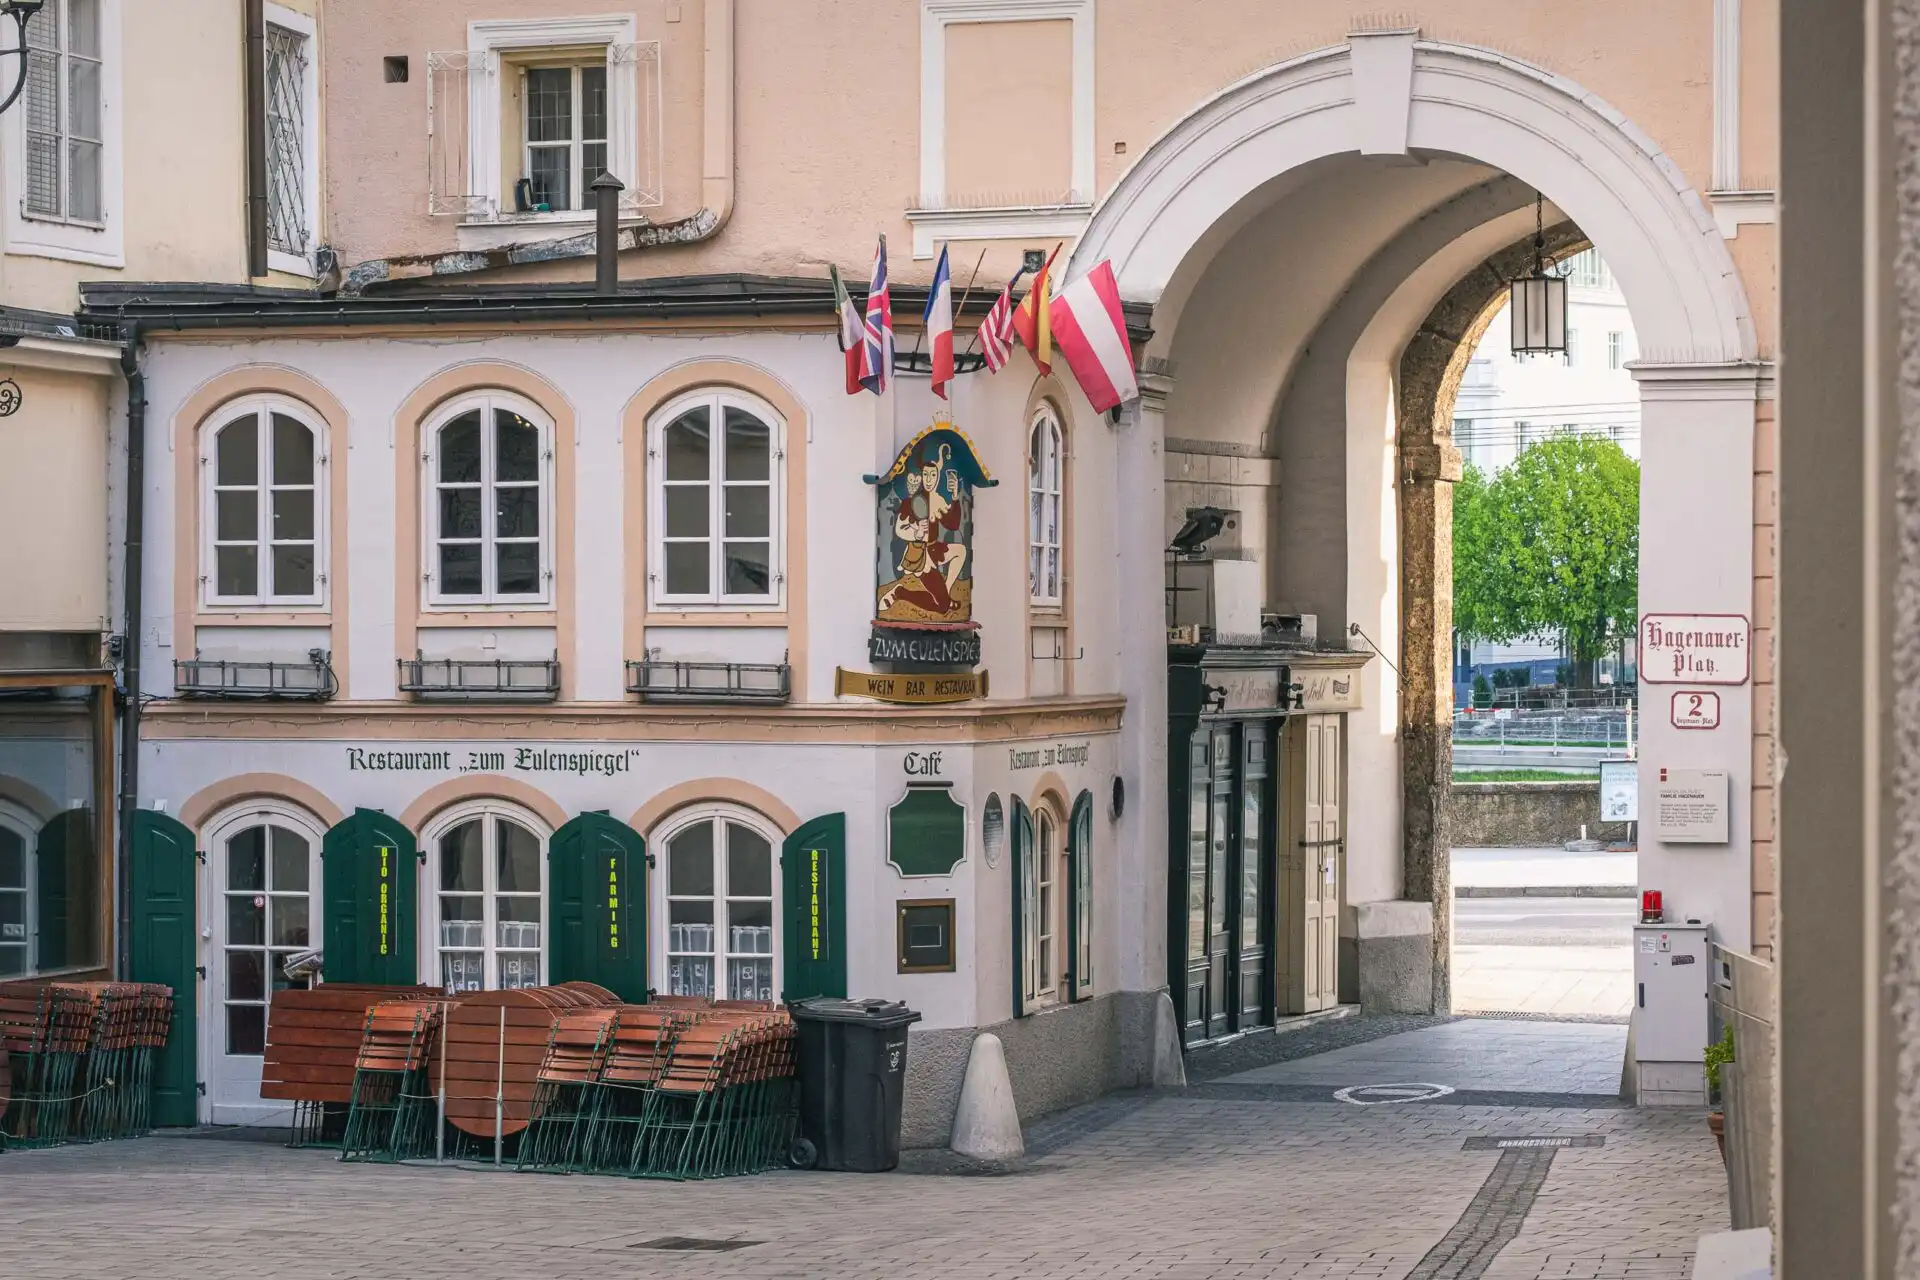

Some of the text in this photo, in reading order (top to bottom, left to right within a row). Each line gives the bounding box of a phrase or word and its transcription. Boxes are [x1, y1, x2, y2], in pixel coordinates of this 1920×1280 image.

[867, 678, 895, 695] WEIN
[905, 680, 926, 696] BAR
[1688, 694, 1703, 717] 2
[346, 747, 451, 771] Restaurant
[903, 751, 942, 777] Café
[1009, 748, 1040, 771] Restaurant
[609, 858, 618, 948] FARMING
[811, 849, 819, 960] RESTAURANT
[380, 883, 388, 955] ORGANIC
